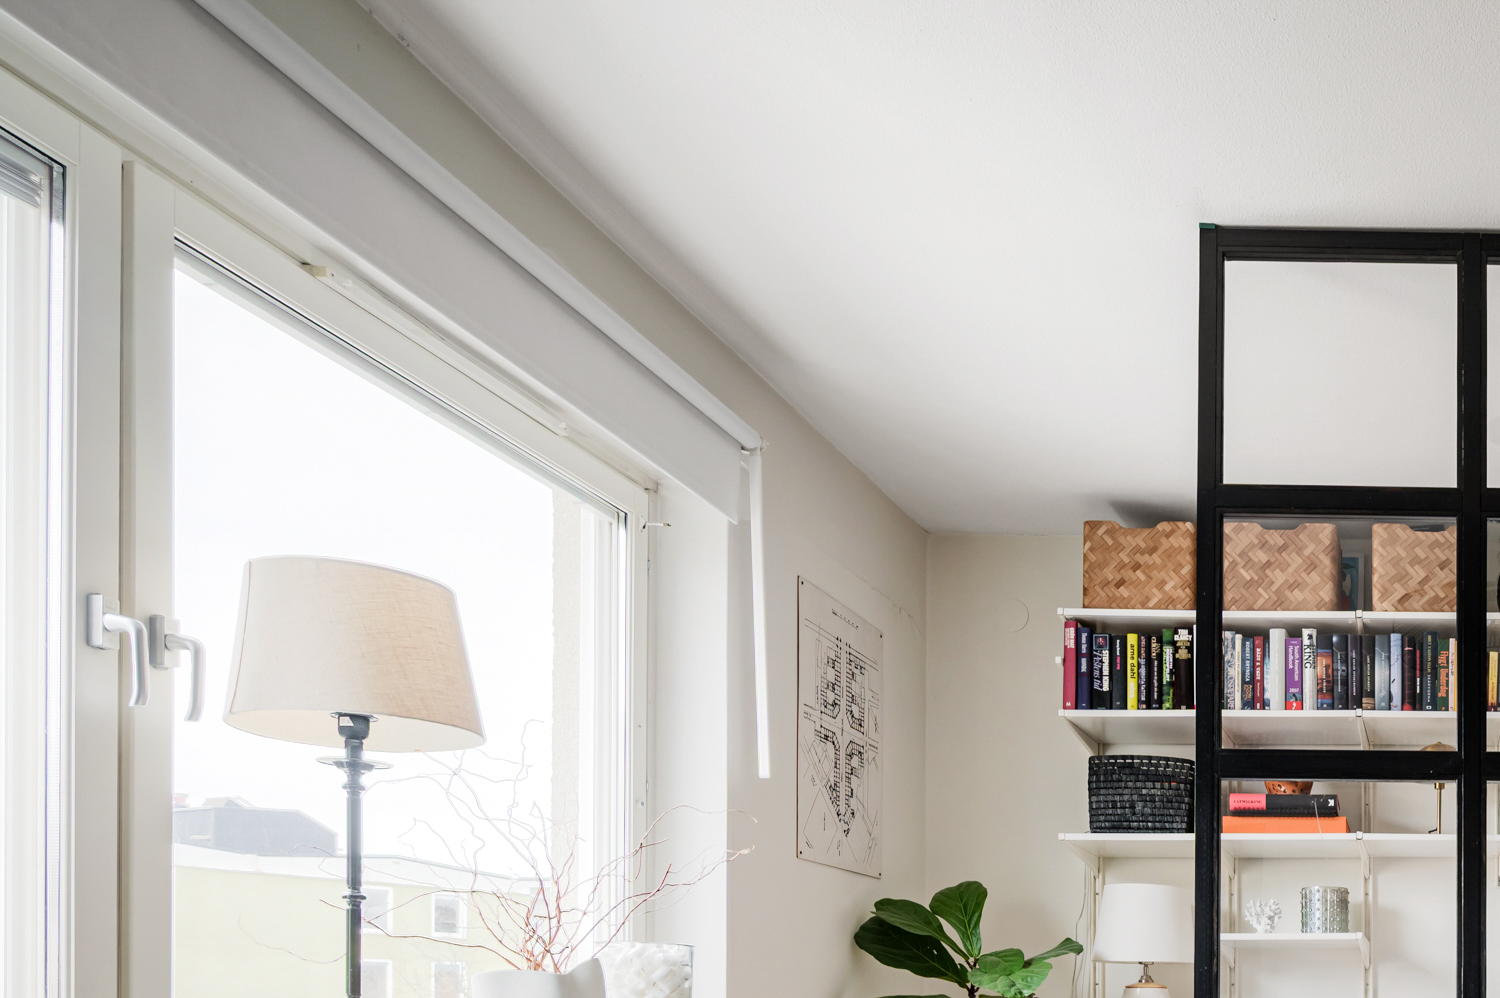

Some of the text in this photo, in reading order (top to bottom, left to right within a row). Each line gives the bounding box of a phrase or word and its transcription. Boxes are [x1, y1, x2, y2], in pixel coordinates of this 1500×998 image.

[1094, 650, 1102, 691] Pestens tid
[1438, 651, 1448, 697] Flygt Underdog
